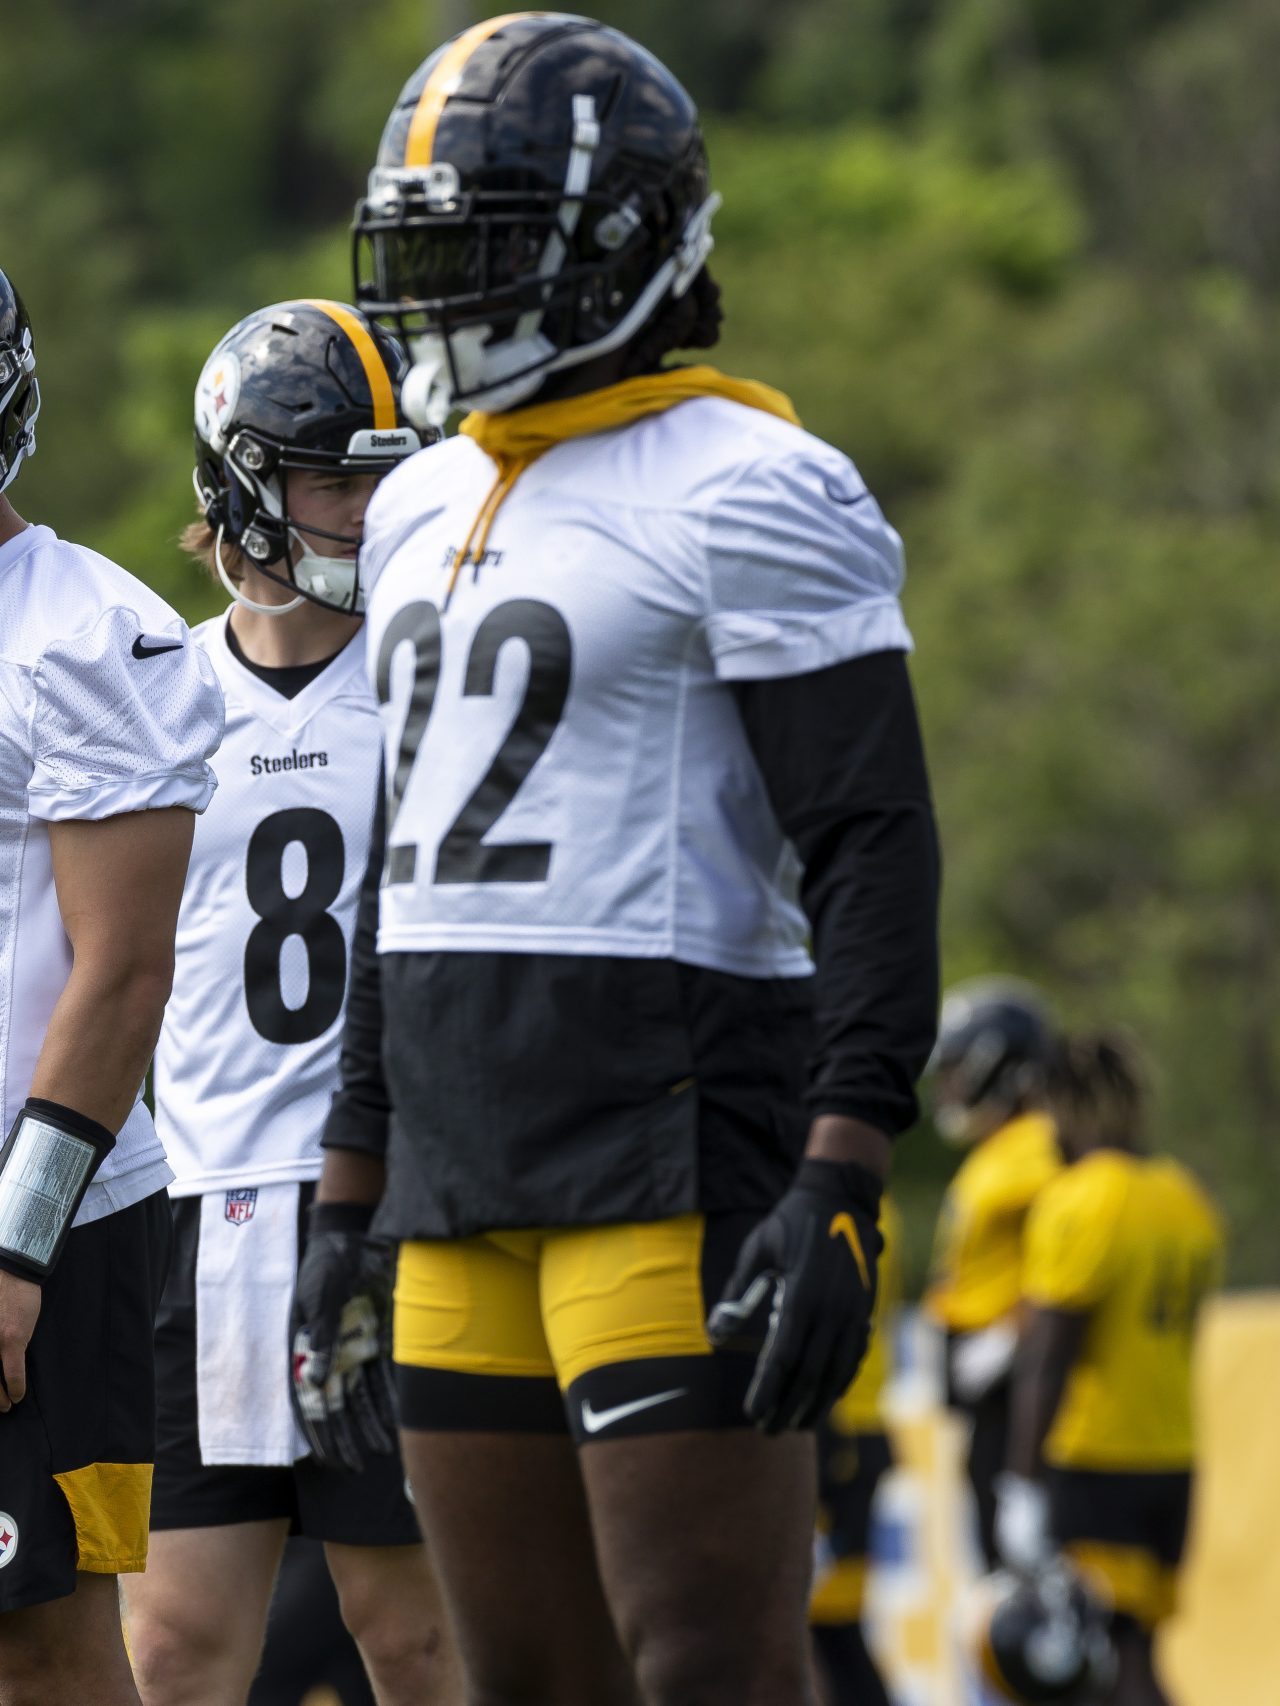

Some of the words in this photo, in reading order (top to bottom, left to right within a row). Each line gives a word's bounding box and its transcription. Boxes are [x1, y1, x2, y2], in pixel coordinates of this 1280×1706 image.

[370, 433, 407, 447] Steelers
[250, 748, 328, 776] Steelers
[376, 597, 574, 885] 22
[244, 806, 347, 1045] 8
